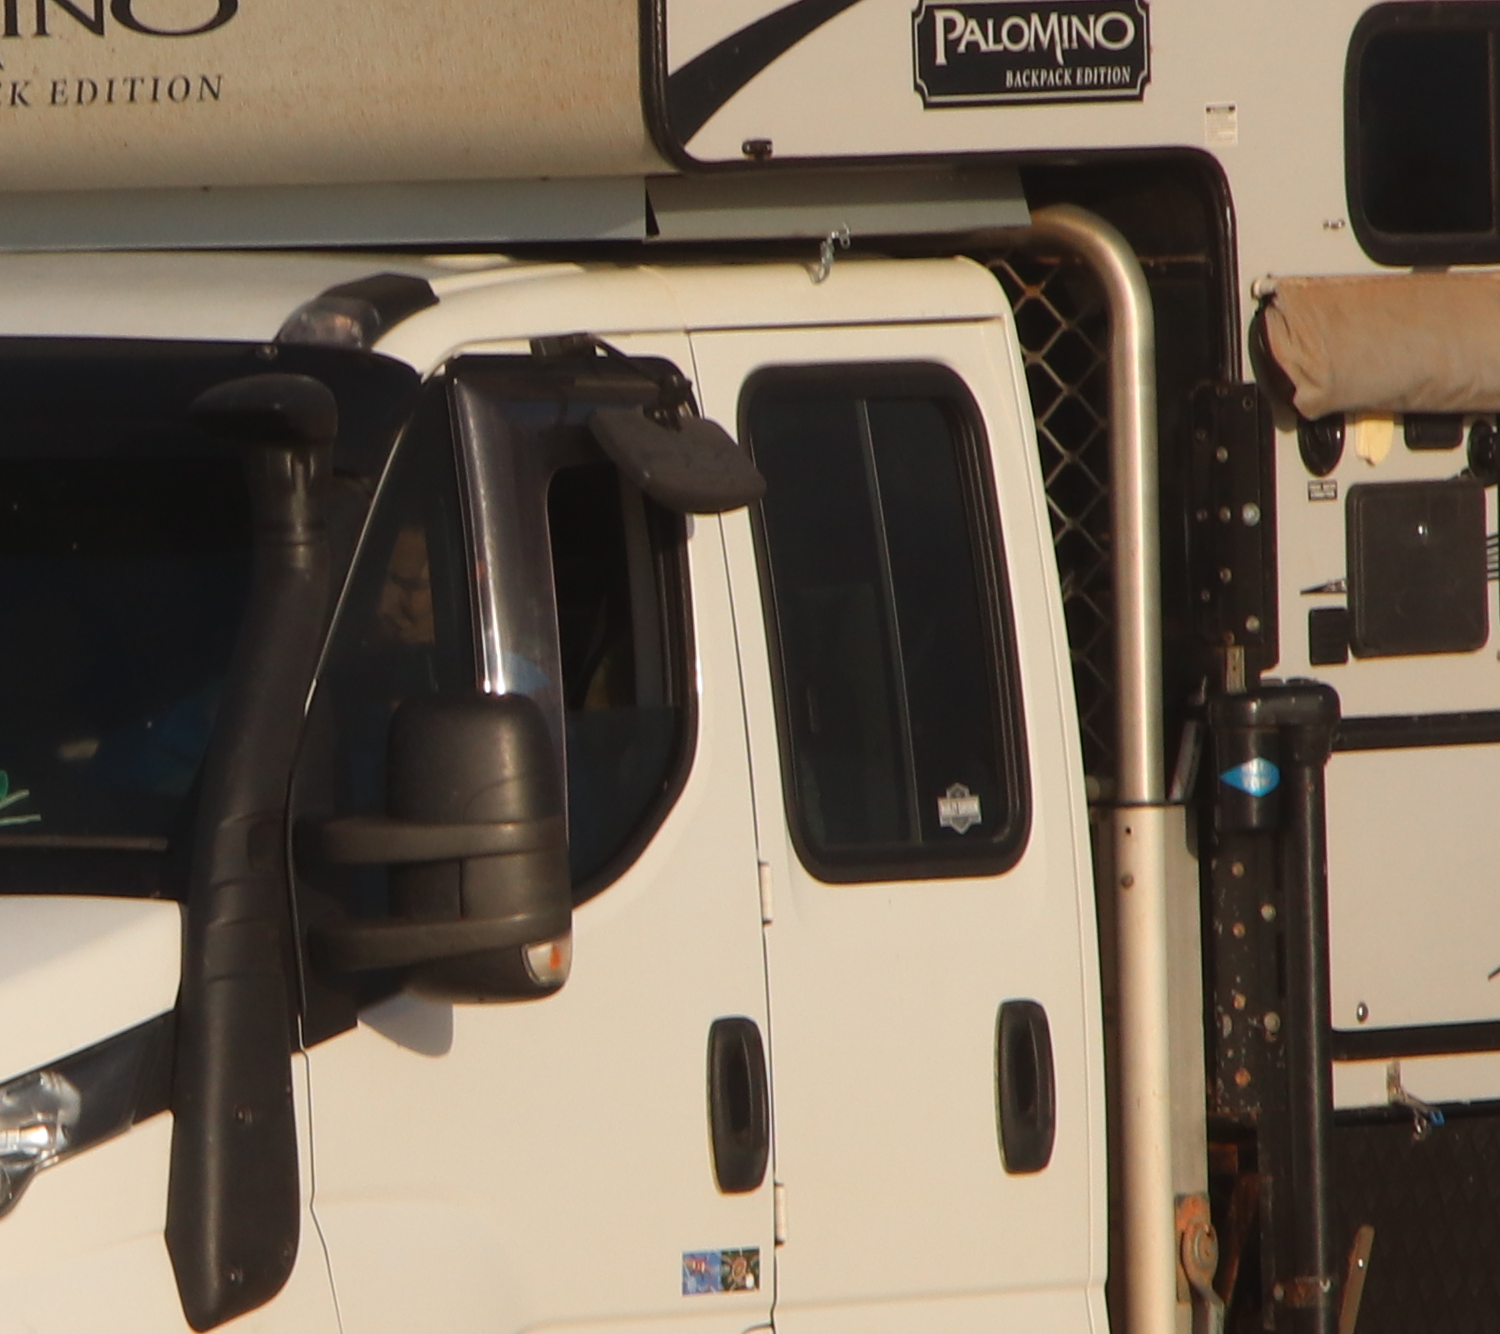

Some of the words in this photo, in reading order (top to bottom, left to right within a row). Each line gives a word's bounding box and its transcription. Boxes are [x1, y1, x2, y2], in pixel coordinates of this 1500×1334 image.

[933, 8, 1136, 66] PALOMINO
[49, 73, 224, 108] EDITION
[1004, 68, 1073, 89] BACKPACK
[1075, 65, 1132, 86] EDITION
